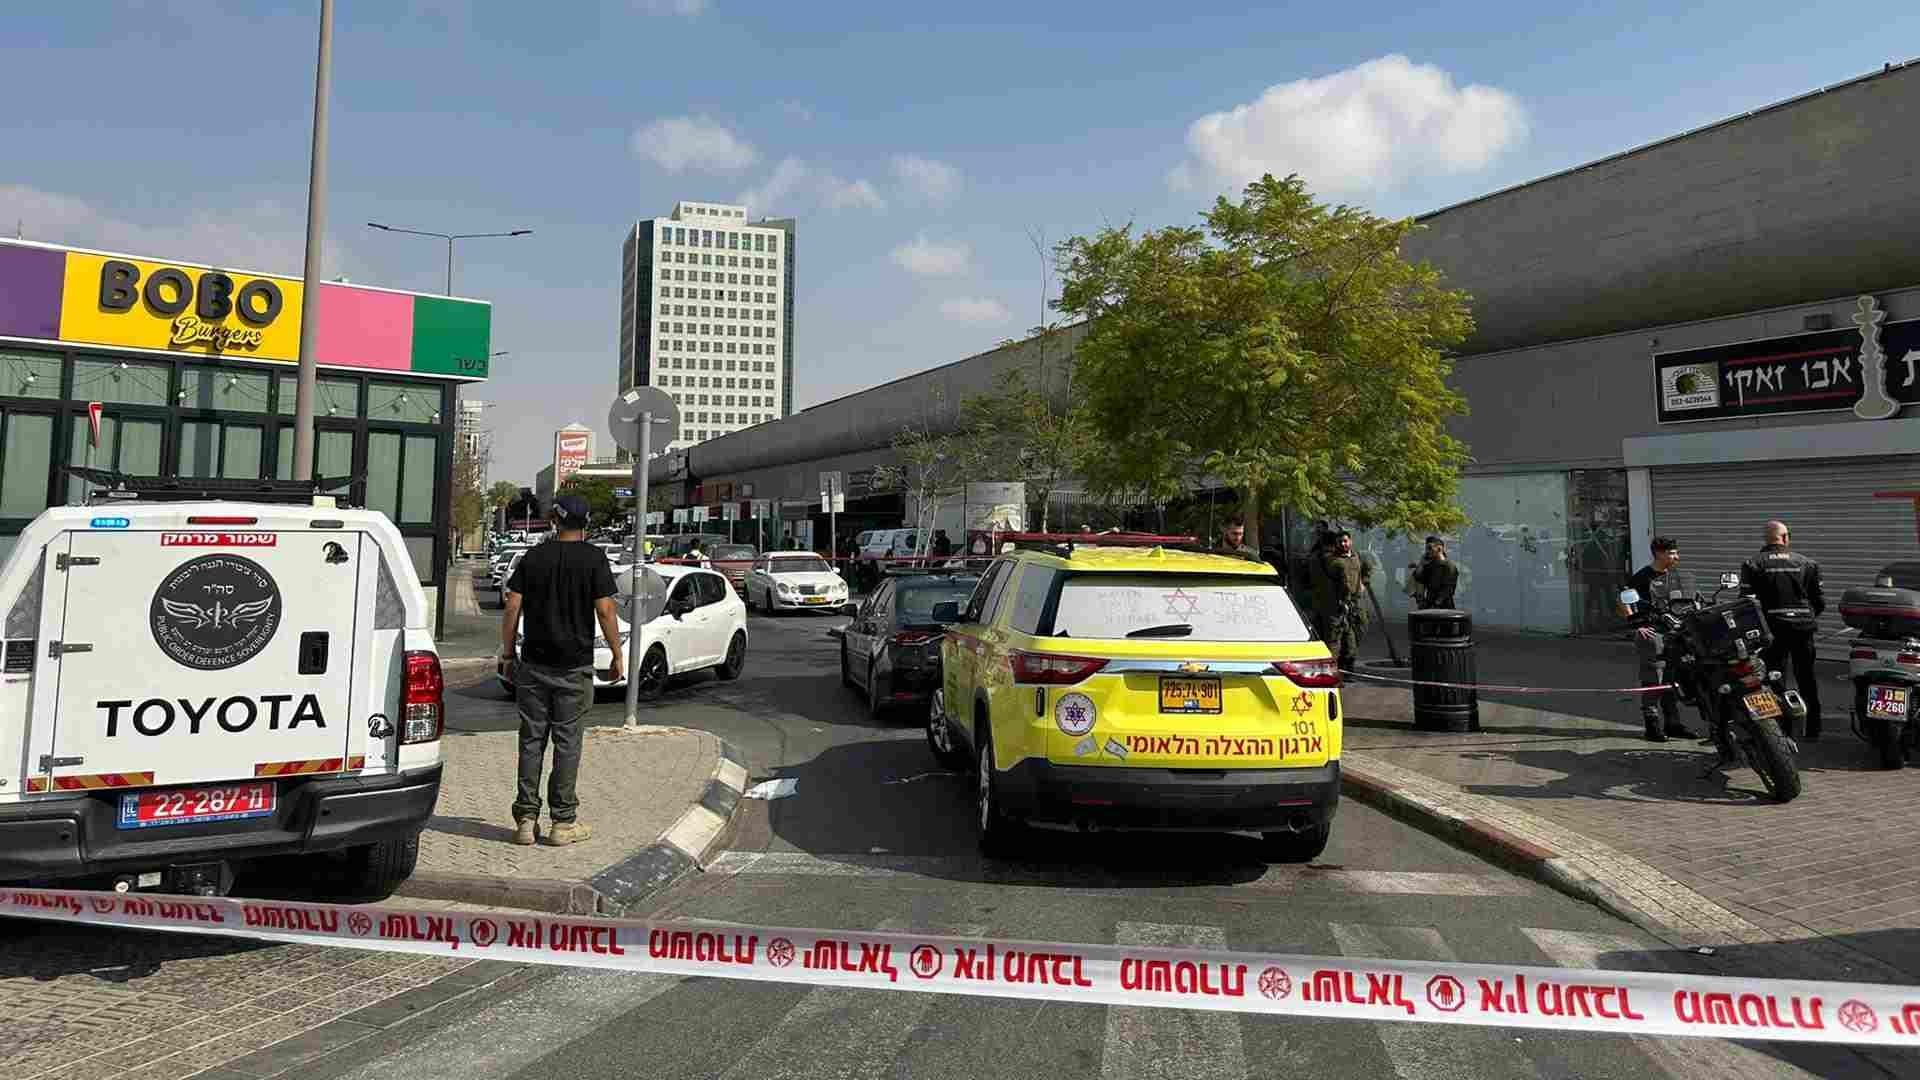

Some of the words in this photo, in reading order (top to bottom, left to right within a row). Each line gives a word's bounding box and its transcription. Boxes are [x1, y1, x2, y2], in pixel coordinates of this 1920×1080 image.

[99, 260, 283, 327] BOBO
[173, 315, 264, 350] Burgers
[1801, 356, 1853, 389] אבו
[1725, 364, 1787, 407] זאקי
[163, 533, 219, 546] מרחק
[225, 533, 274, 545] שמור
[168, 642, 195, 662] ORDER
[96, 694, 327, 737] TOYOTA
[1291, 720, 1316, 735] 101
[1126, 734, 1200, 755] הלאומי
[1205, 735, 1273, 756] ההצלה
[1279, 736, 1322, 760] ארגון
[241, 904, 338, 932] משטרת
[378, 913, 460, 949] ישראל
[507, 919, 542, 948] אין
[550, 923, 625, 955] מעבר
[648, 927, 758, 965] משטרת
[803, 939, 898, 982] ישראל
[953, 944, 996, 981] אין
[1003, 950, 1093, 988] מעבר
[1119, 957, 1248, 997] משטרת
[1301, 969, 1416, 1015] ישראל
[1477, 974, 1529, 1014] אין
[1535, 981, 1645, 1020] מעבר
[1672, 989, 1826, 1031] משטרת
